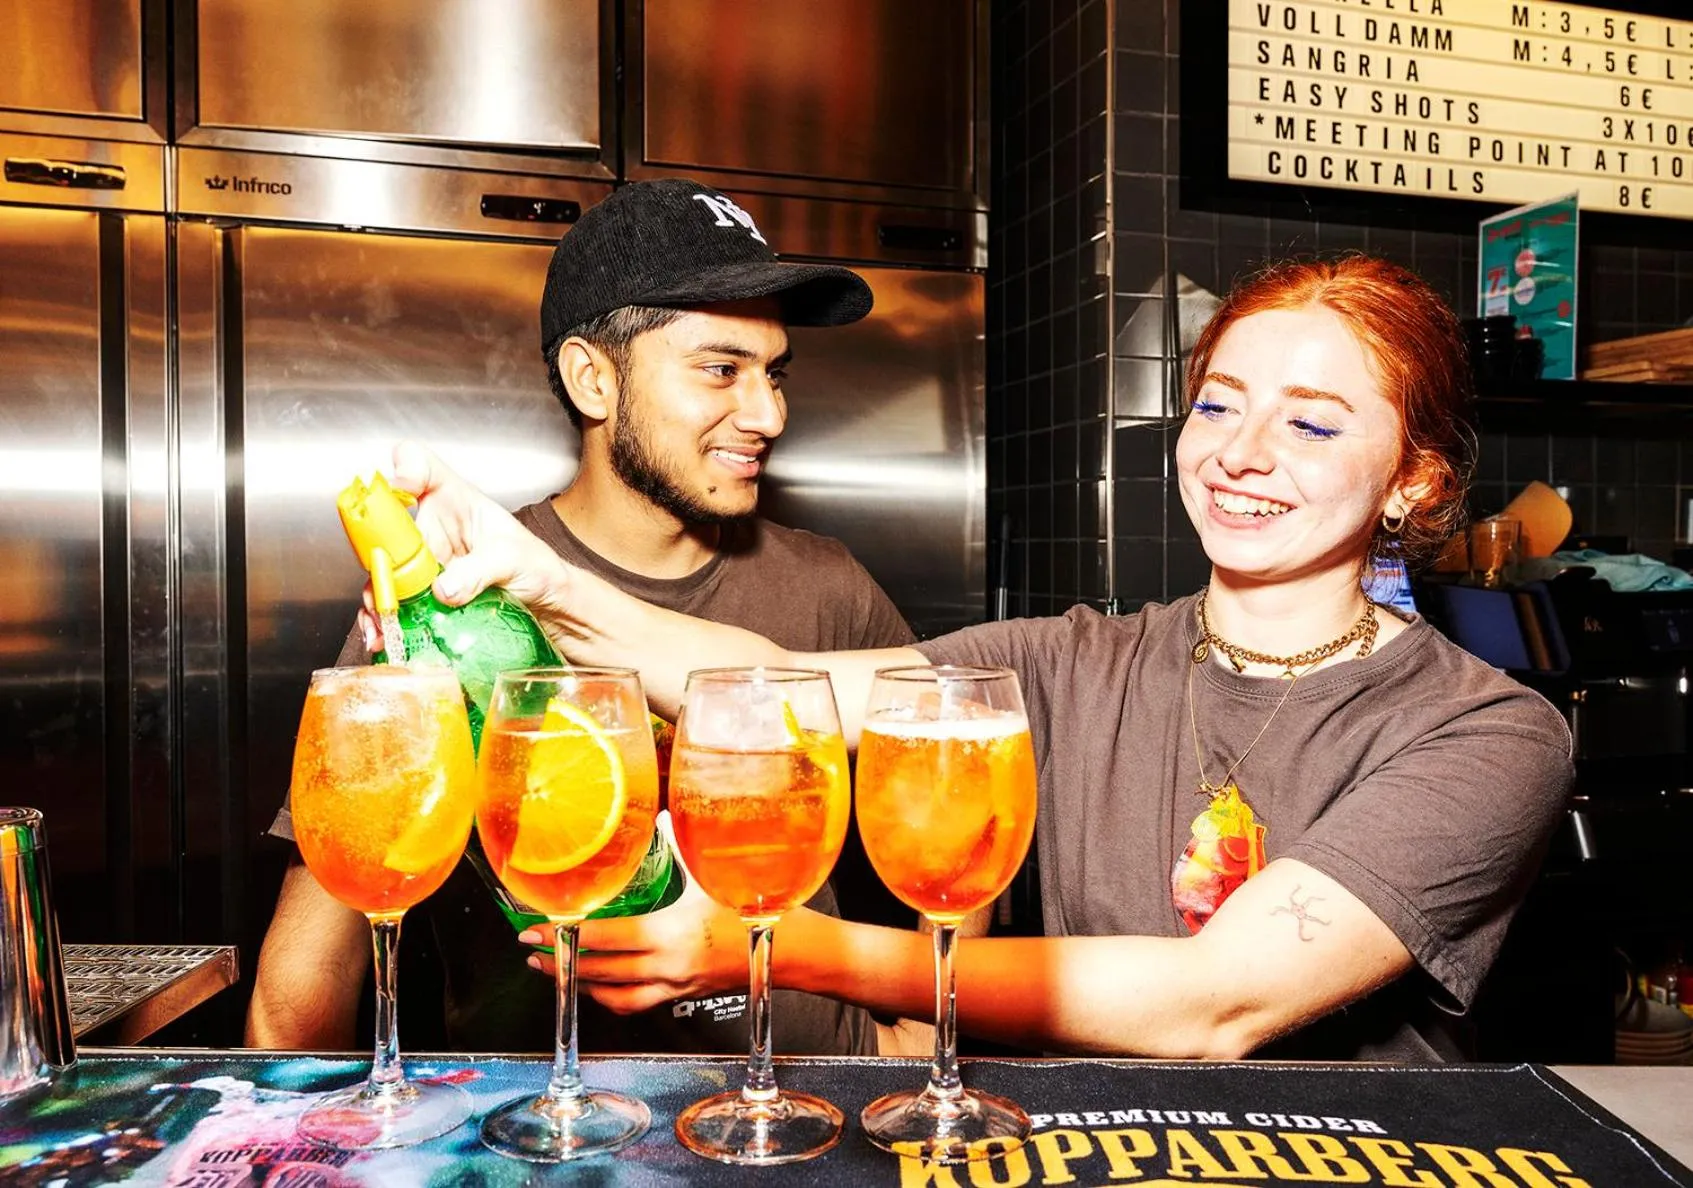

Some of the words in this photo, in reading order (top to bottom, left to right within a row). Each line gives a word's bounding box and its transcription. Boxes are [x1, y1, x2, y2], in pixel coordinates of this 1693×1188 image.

[1257, 3, 1345, 38] VOLL
[1365, 18, 1452, 52] DAMM
[1257, 40, 1419, 82] SANGRIA
[1259, 77, 1348, 109] EASY
[1371, 90, 1479, 125] SHOTS
[1268, 150, 1484, 194] COCKTAILS
[1469, 136, 1571, 168] POINT
[1594, 149, 1629, 173] AT
[1651, 155, 1683, 178] 10
[233, 176, 292, 195] Infrico
[1030, 1108, 1233, 1129] PREMIUM
[1245, 1112, 1388, 1134] CIDER
[890, 1128, 1594, 1188] KOPPARBERG
